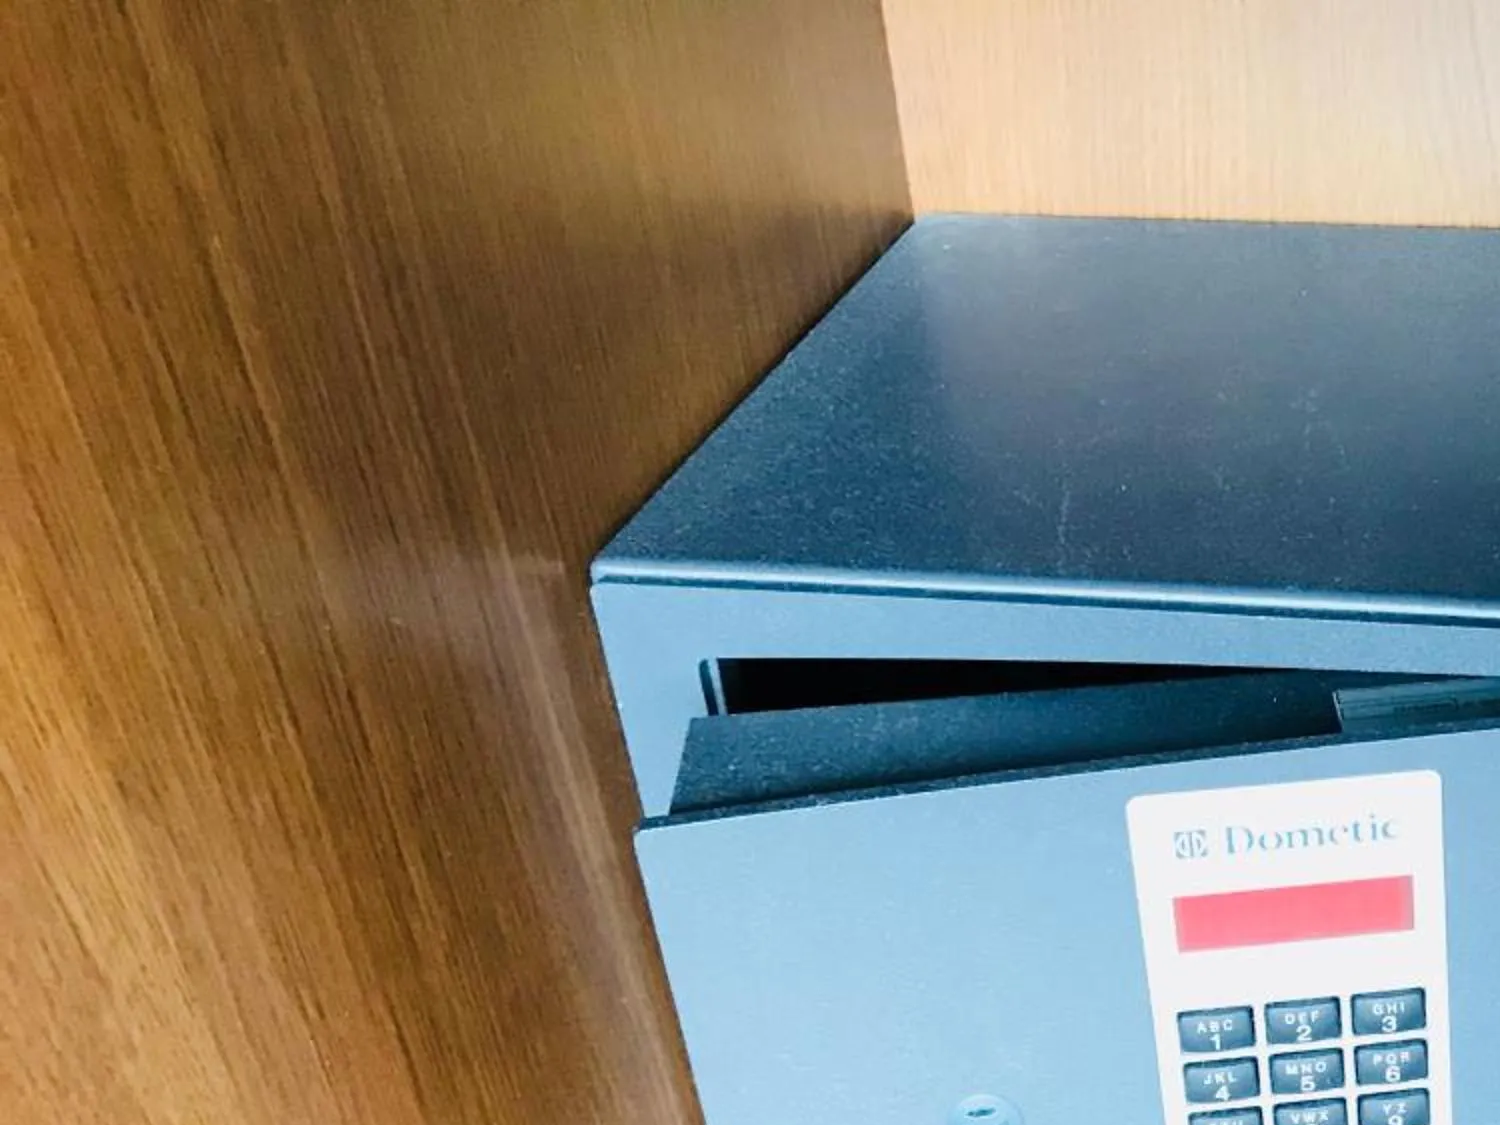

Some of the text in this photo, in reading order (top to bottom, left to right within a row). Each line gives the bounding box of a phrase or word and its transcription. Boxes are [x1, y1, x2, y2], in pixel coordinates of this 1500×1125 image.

[1226, 813, 1399, 855] Dometic
[1296, 1024, 1312, 1042] 2
[1381, 1015, 1397, 1033] 3
[1210, 1034, 1222, 1051] 1
[1285, 1061, 1328, 1076] MNO
[1385, 1065, 1401, 1083] 6
[1215, 1083, 1230, 1101] 4
[1300, 1074, 1316, 1092] 5
